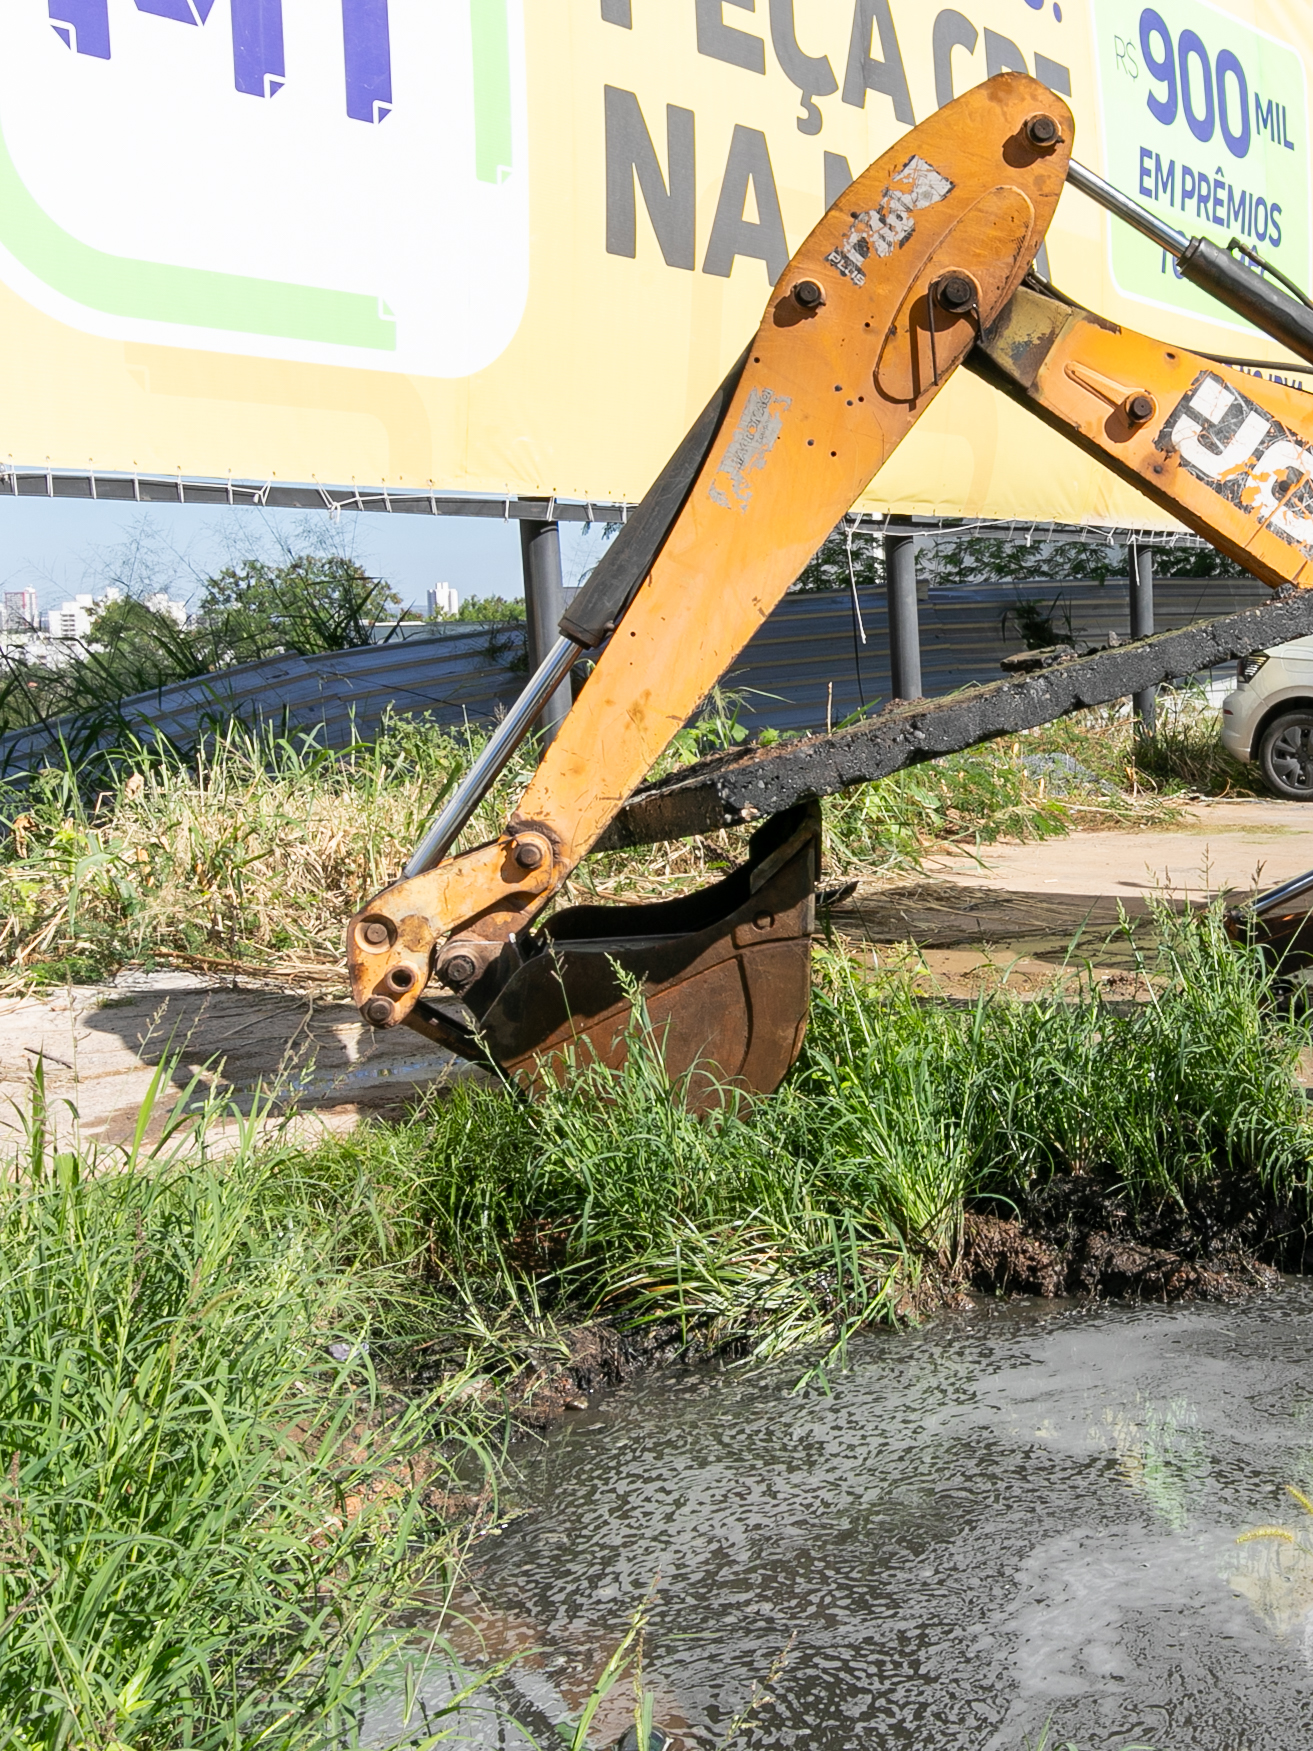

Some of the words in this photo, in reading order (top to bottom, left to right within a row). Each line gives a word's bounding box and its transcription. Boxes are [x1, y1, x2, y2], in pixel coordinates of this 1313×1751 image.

[1113, 35, 1139, 82] R$
[1139, 8, 1251, 158] 900
[1254, 92, 1295, 151] MIL
[604, 84, 791, 287] NA
[1138, 146, 1175, 202] EM
[1181, 166, 1283, 248] PRÊMIOS
